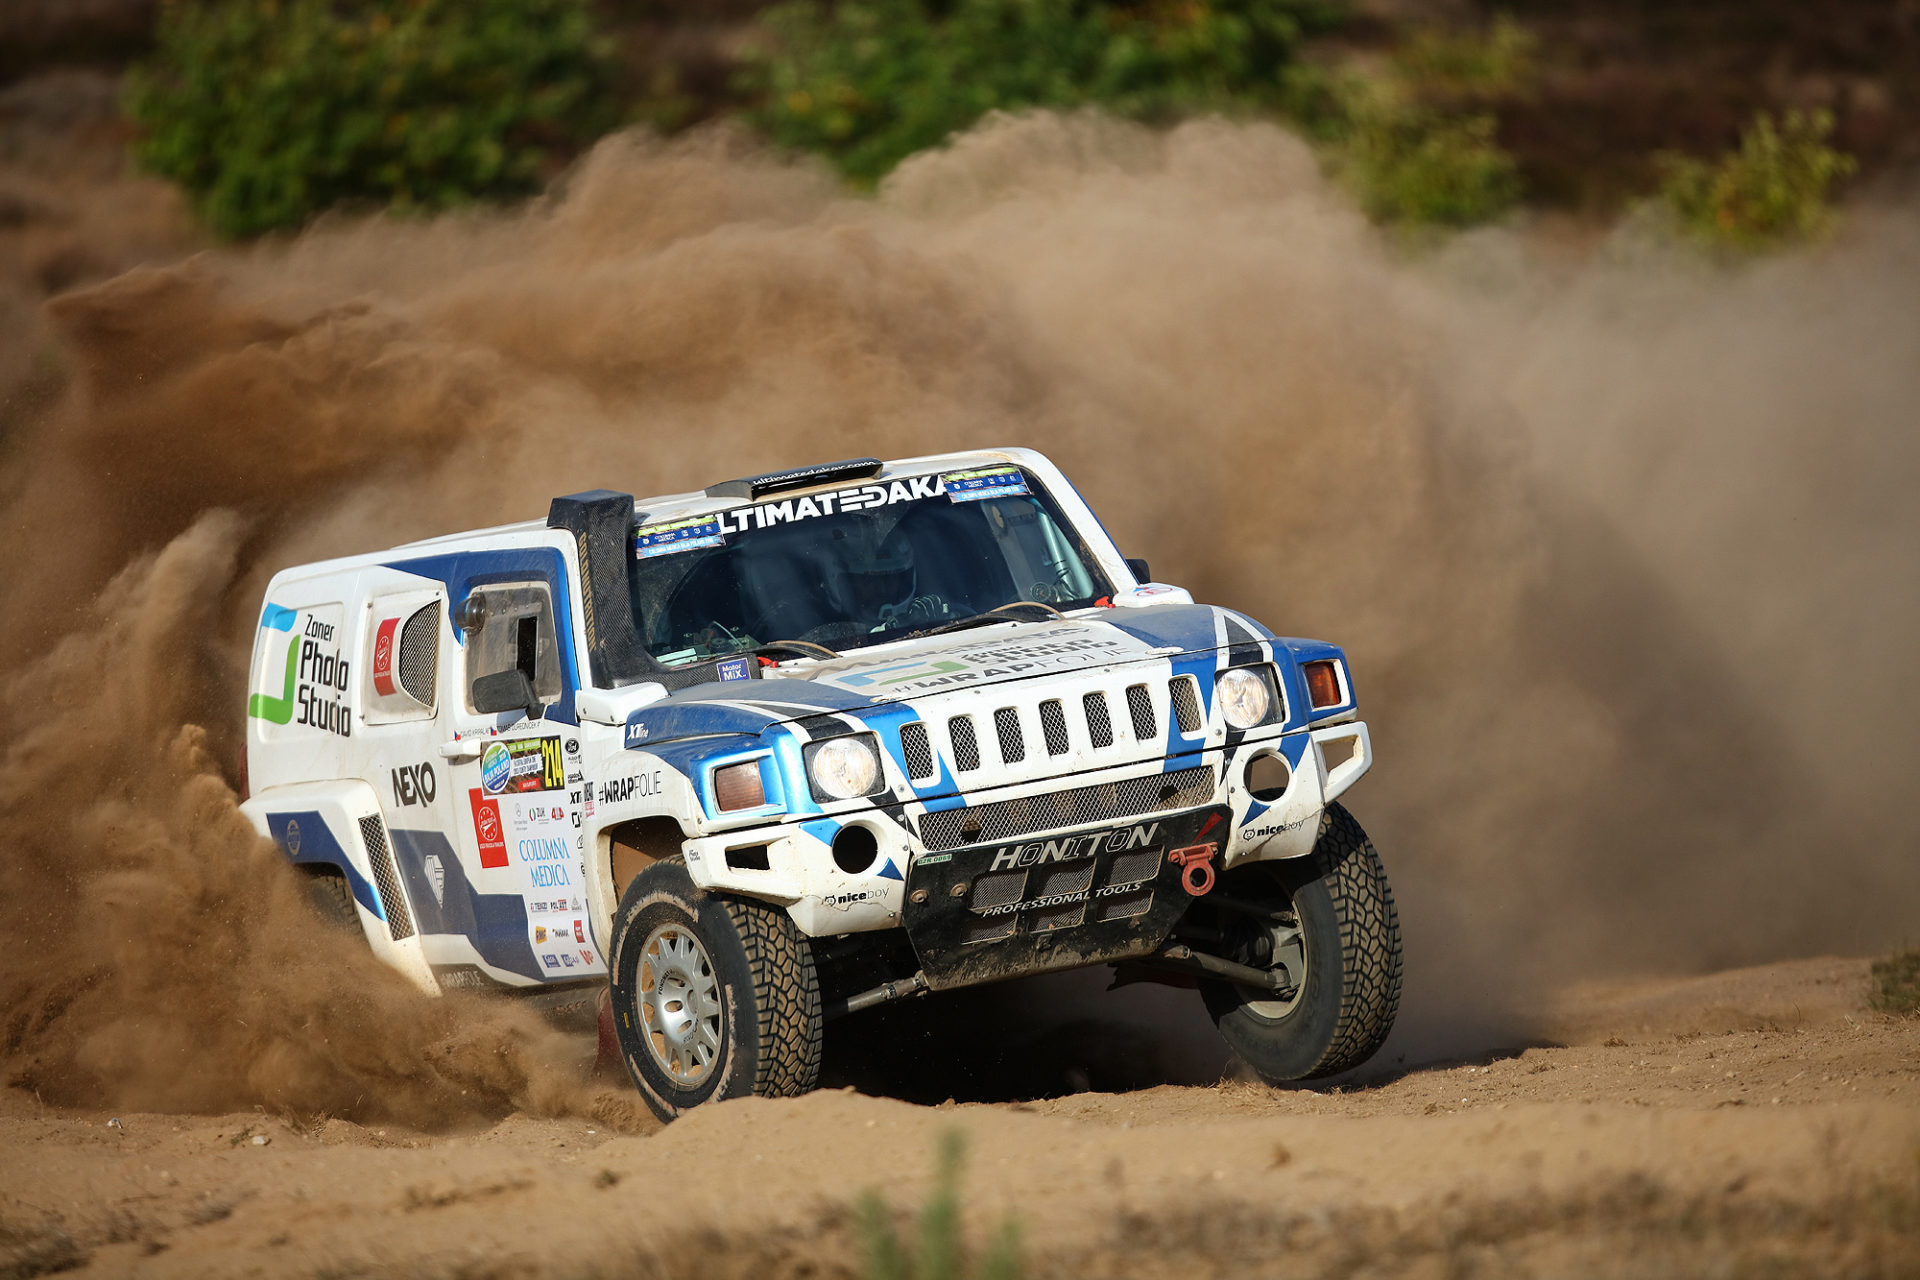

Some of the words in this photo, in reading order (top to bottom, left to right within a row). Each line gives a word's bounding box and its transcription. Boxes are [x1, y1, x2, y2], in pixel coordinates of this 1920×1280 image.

[752, 461, 877, 486] ultimatedakar.com
[690, 473, 948, 534] LTIMATEDAKA
[579, 532, 597, 653] GOLDNUTRITION
[305, 614, 335, 642] Zoner
[300, 640, 349, 692] Photo
[297, 683, 352, 738] Studio
[541, 738, 564, 788] 214
[391, 761, 437, 808] NEXO
[598, 771, 662, 806] #WRAPFOLIE
[519, 837, 570, 862] COLUMNA
[990, 823, 1159, 871] HONITON
[530, 864, 571, 888] MEDICA
[837, 888, 890, 904] niceboy
[983, 891, 1092, 918] PROFESSIONAL
[1095, 882, 1142, 898] TOOLS
